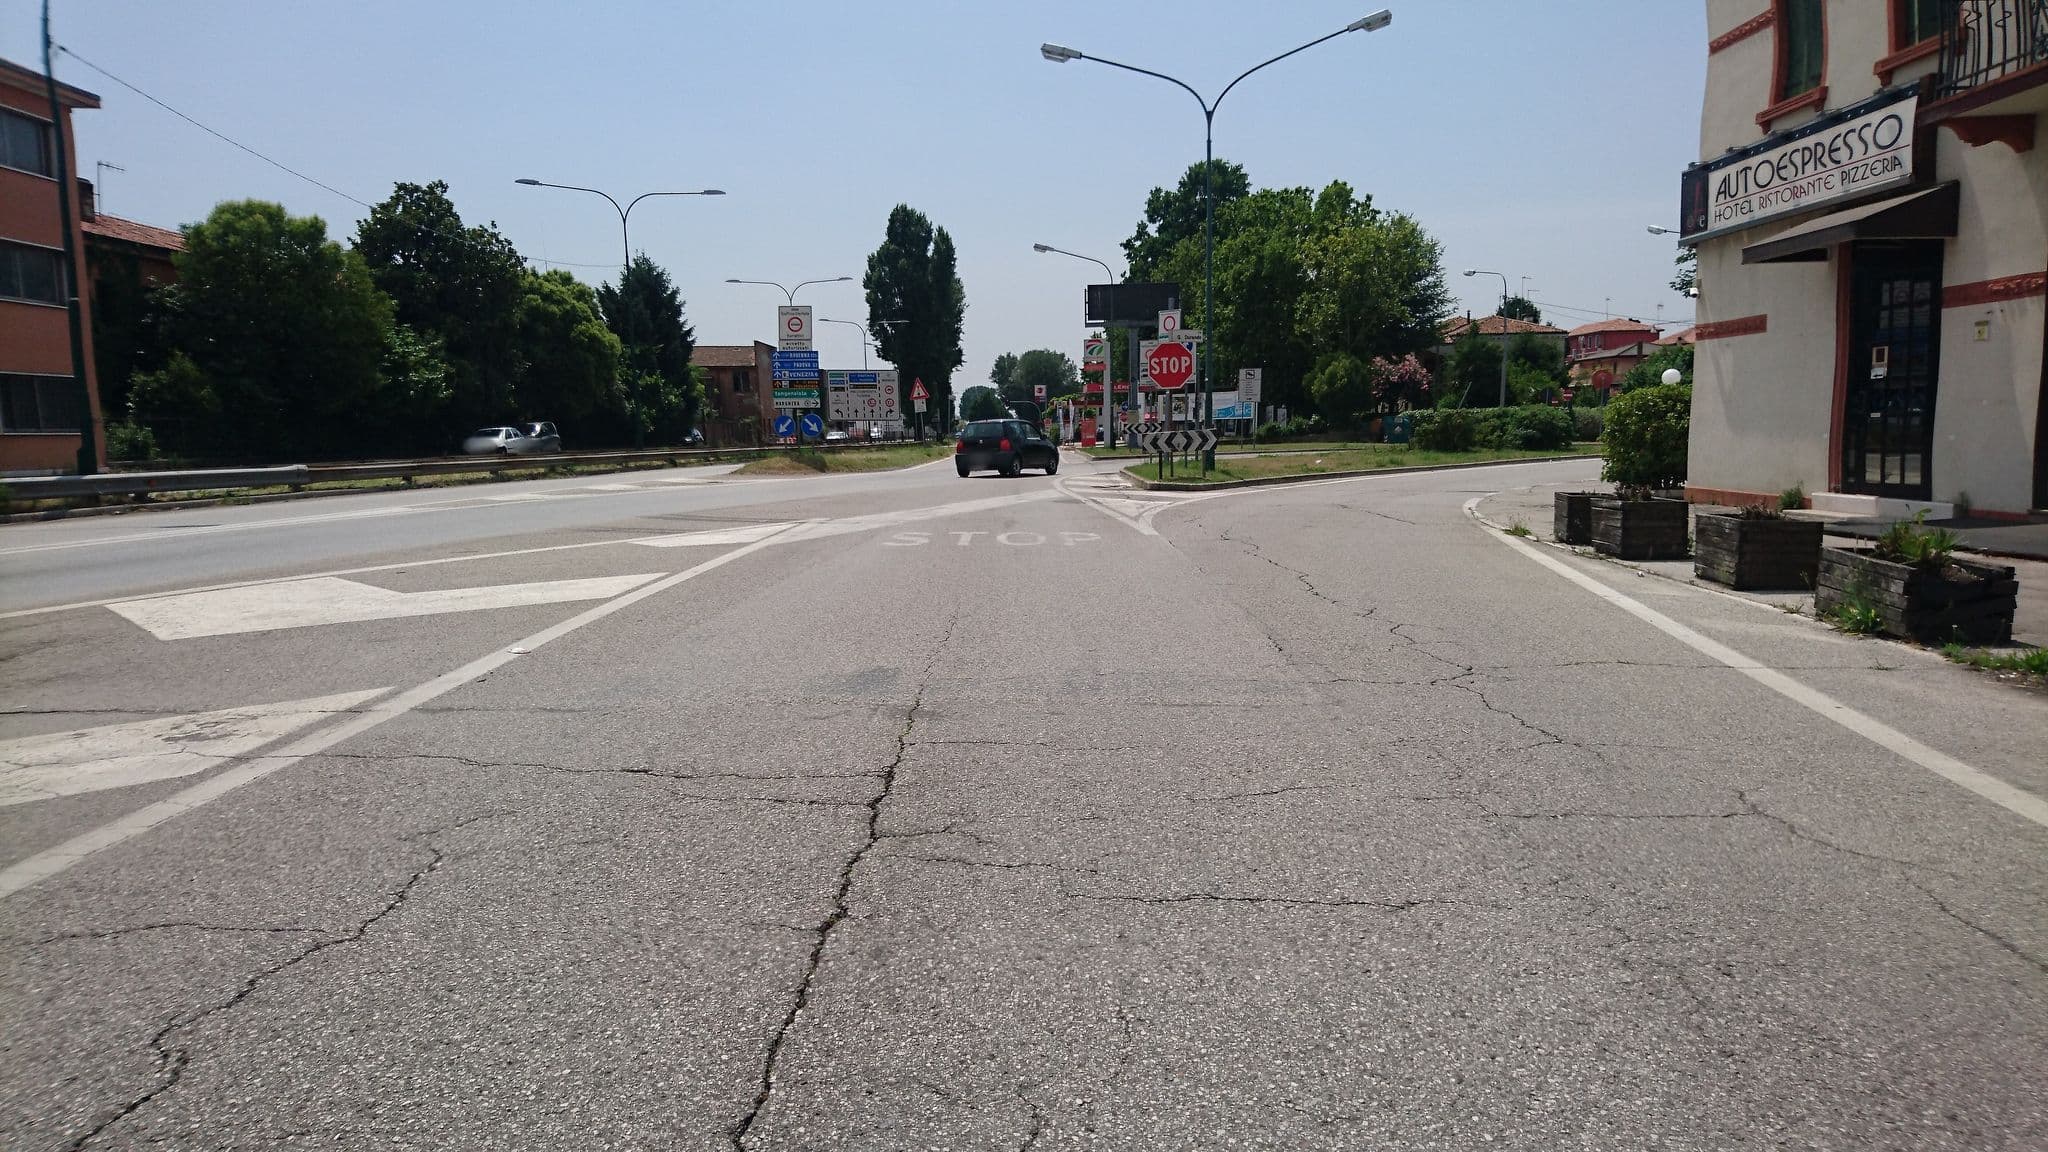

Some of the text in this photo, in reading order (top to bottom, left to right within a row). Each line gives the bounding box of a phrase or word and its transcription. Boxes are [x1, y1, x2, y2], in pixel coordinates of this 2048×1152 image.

[1715, 114, 1903, 203] AUTOESPRESSO
[1714, 156, 1903, 223] HOTEL RISTORANTE PIZZERIA
[1150, 356, 1190, 375] STOP
[881, 531, 1101, 546] STOP
